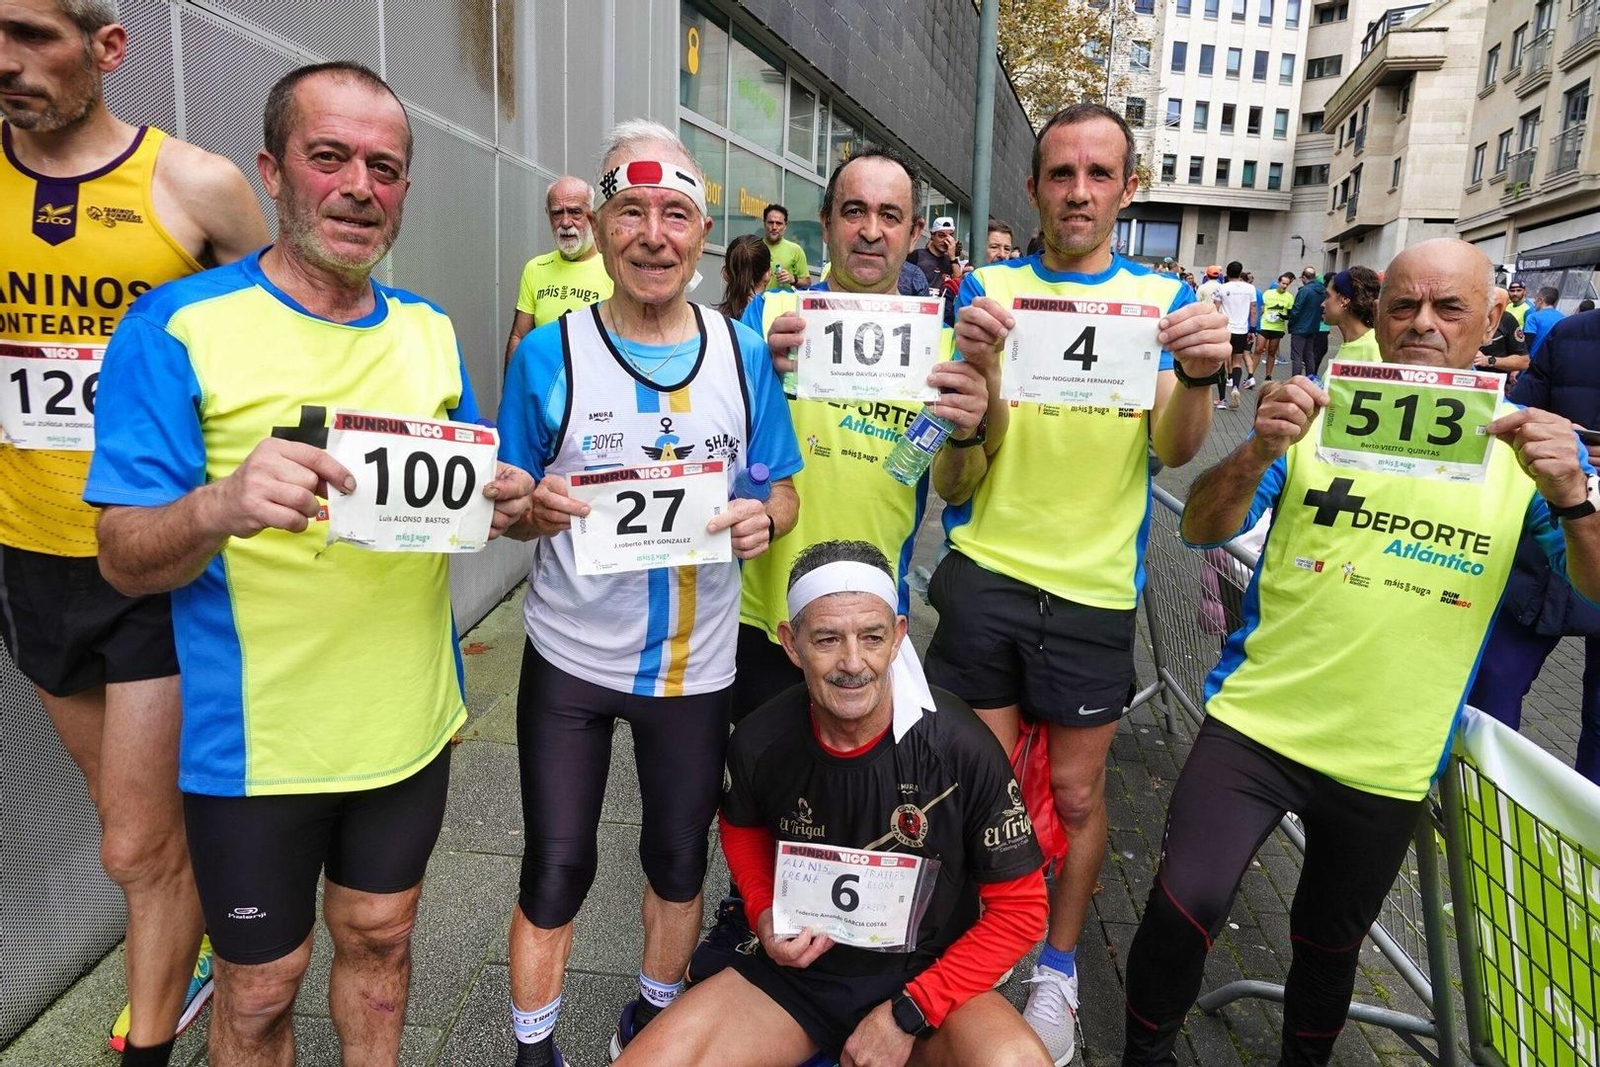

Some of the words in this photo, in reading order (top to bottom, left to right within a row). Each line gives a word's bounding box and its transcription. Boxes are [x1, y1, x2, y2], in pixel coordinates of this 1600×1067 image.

[36, 216, 72, 226] ZICO
[537, 284, 560, 300] máis
[570, 287, 599, 302] auga
[824, 320, 912, 367] 101
[1063, 326, 1098, 371] 4
[589, 411, 613, 420] AMURA
[1345, 390, 1465, 445] 513
[1361, 442, 1379, 450] Berto
[1407, 448, 1440, 457] QUINTAS
[364, 447, 476, 510] 100
[379, 514, 392, 522] Luis
[394, 515, 421, 523] ALONSO
[616, 488, 686, 536] 27
[1382, 538, 1486, 576] Atlántico
[1442, 590, 1460, 599] RUN
[780, 817, 788, 831] El
[790, 820, 825, 839] Trigal
[831, 873, 860, 913] 6
[844, 917, 865, 927] GARCIA
